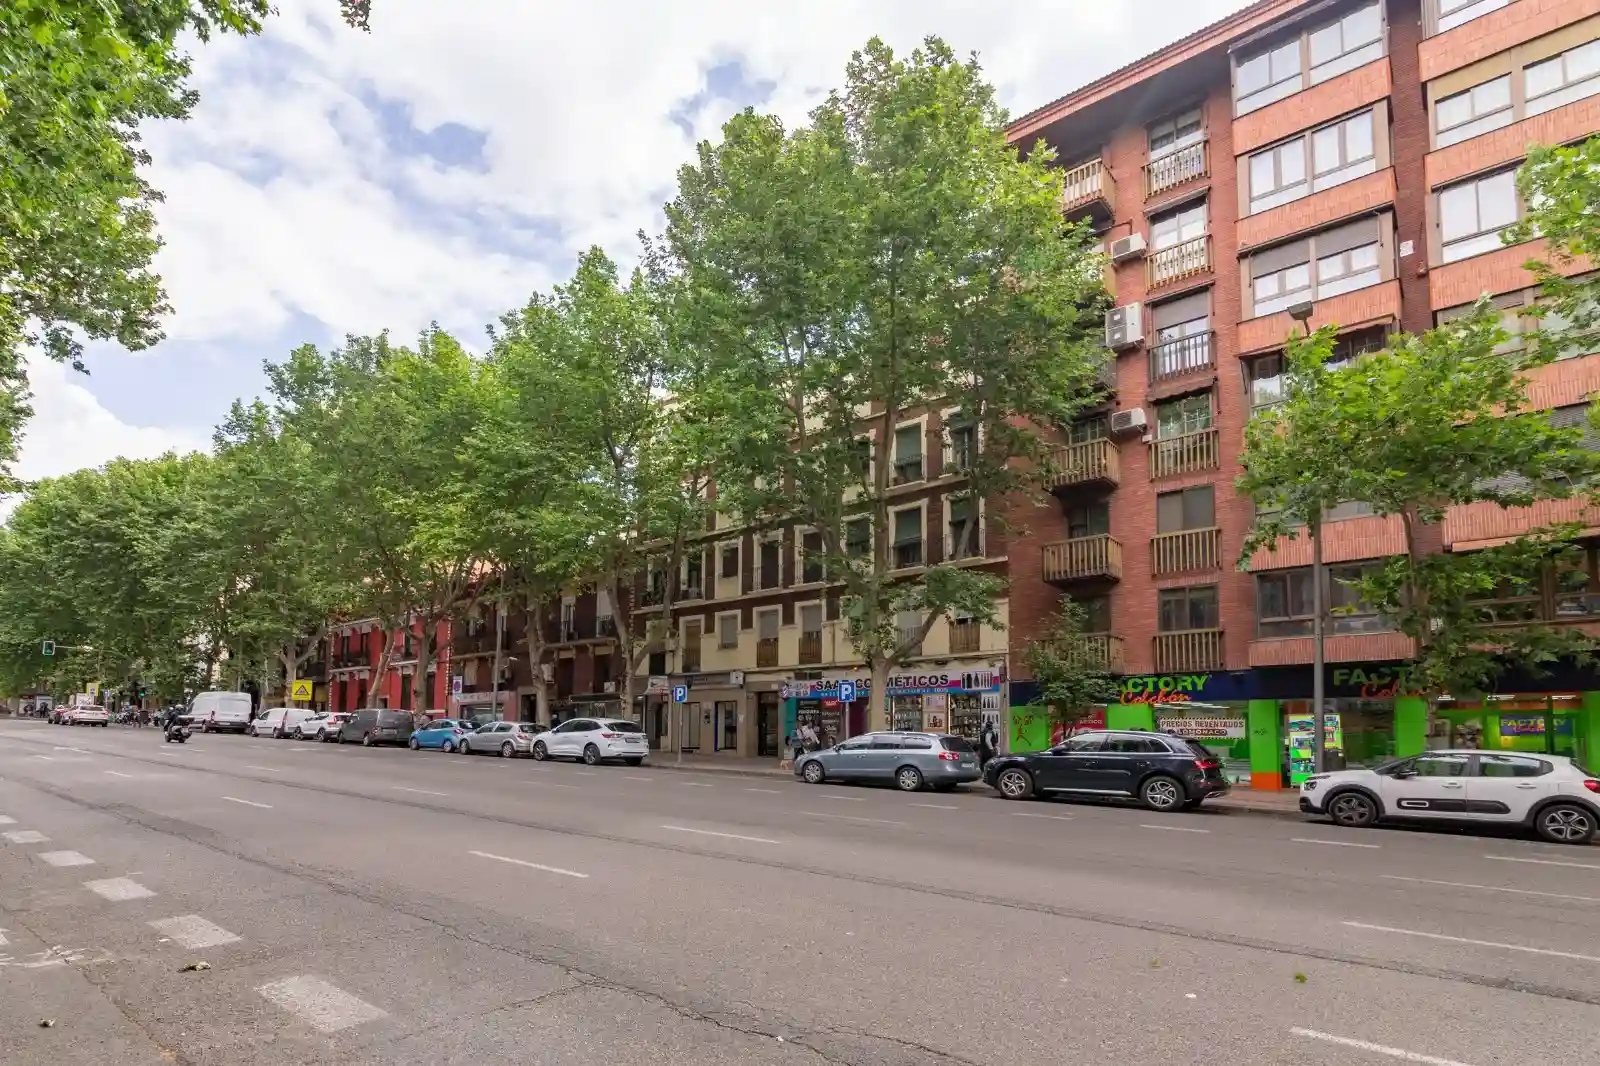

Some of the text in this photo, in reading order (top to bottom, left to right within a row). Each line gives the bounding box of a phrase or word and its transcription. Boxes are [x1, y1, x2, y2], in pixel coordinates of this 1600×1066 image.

[816, 674, 949, 690] SAA COMÉTICOS
[1122, 675, 1209, 692] CTORY
[1333, 665, 1412, 686] FACT
[676, 687, 684, 700] P
[841, 684, 852, 700] P
[1161, 720, 1245, 728] PRECIOS REVENTADOS
